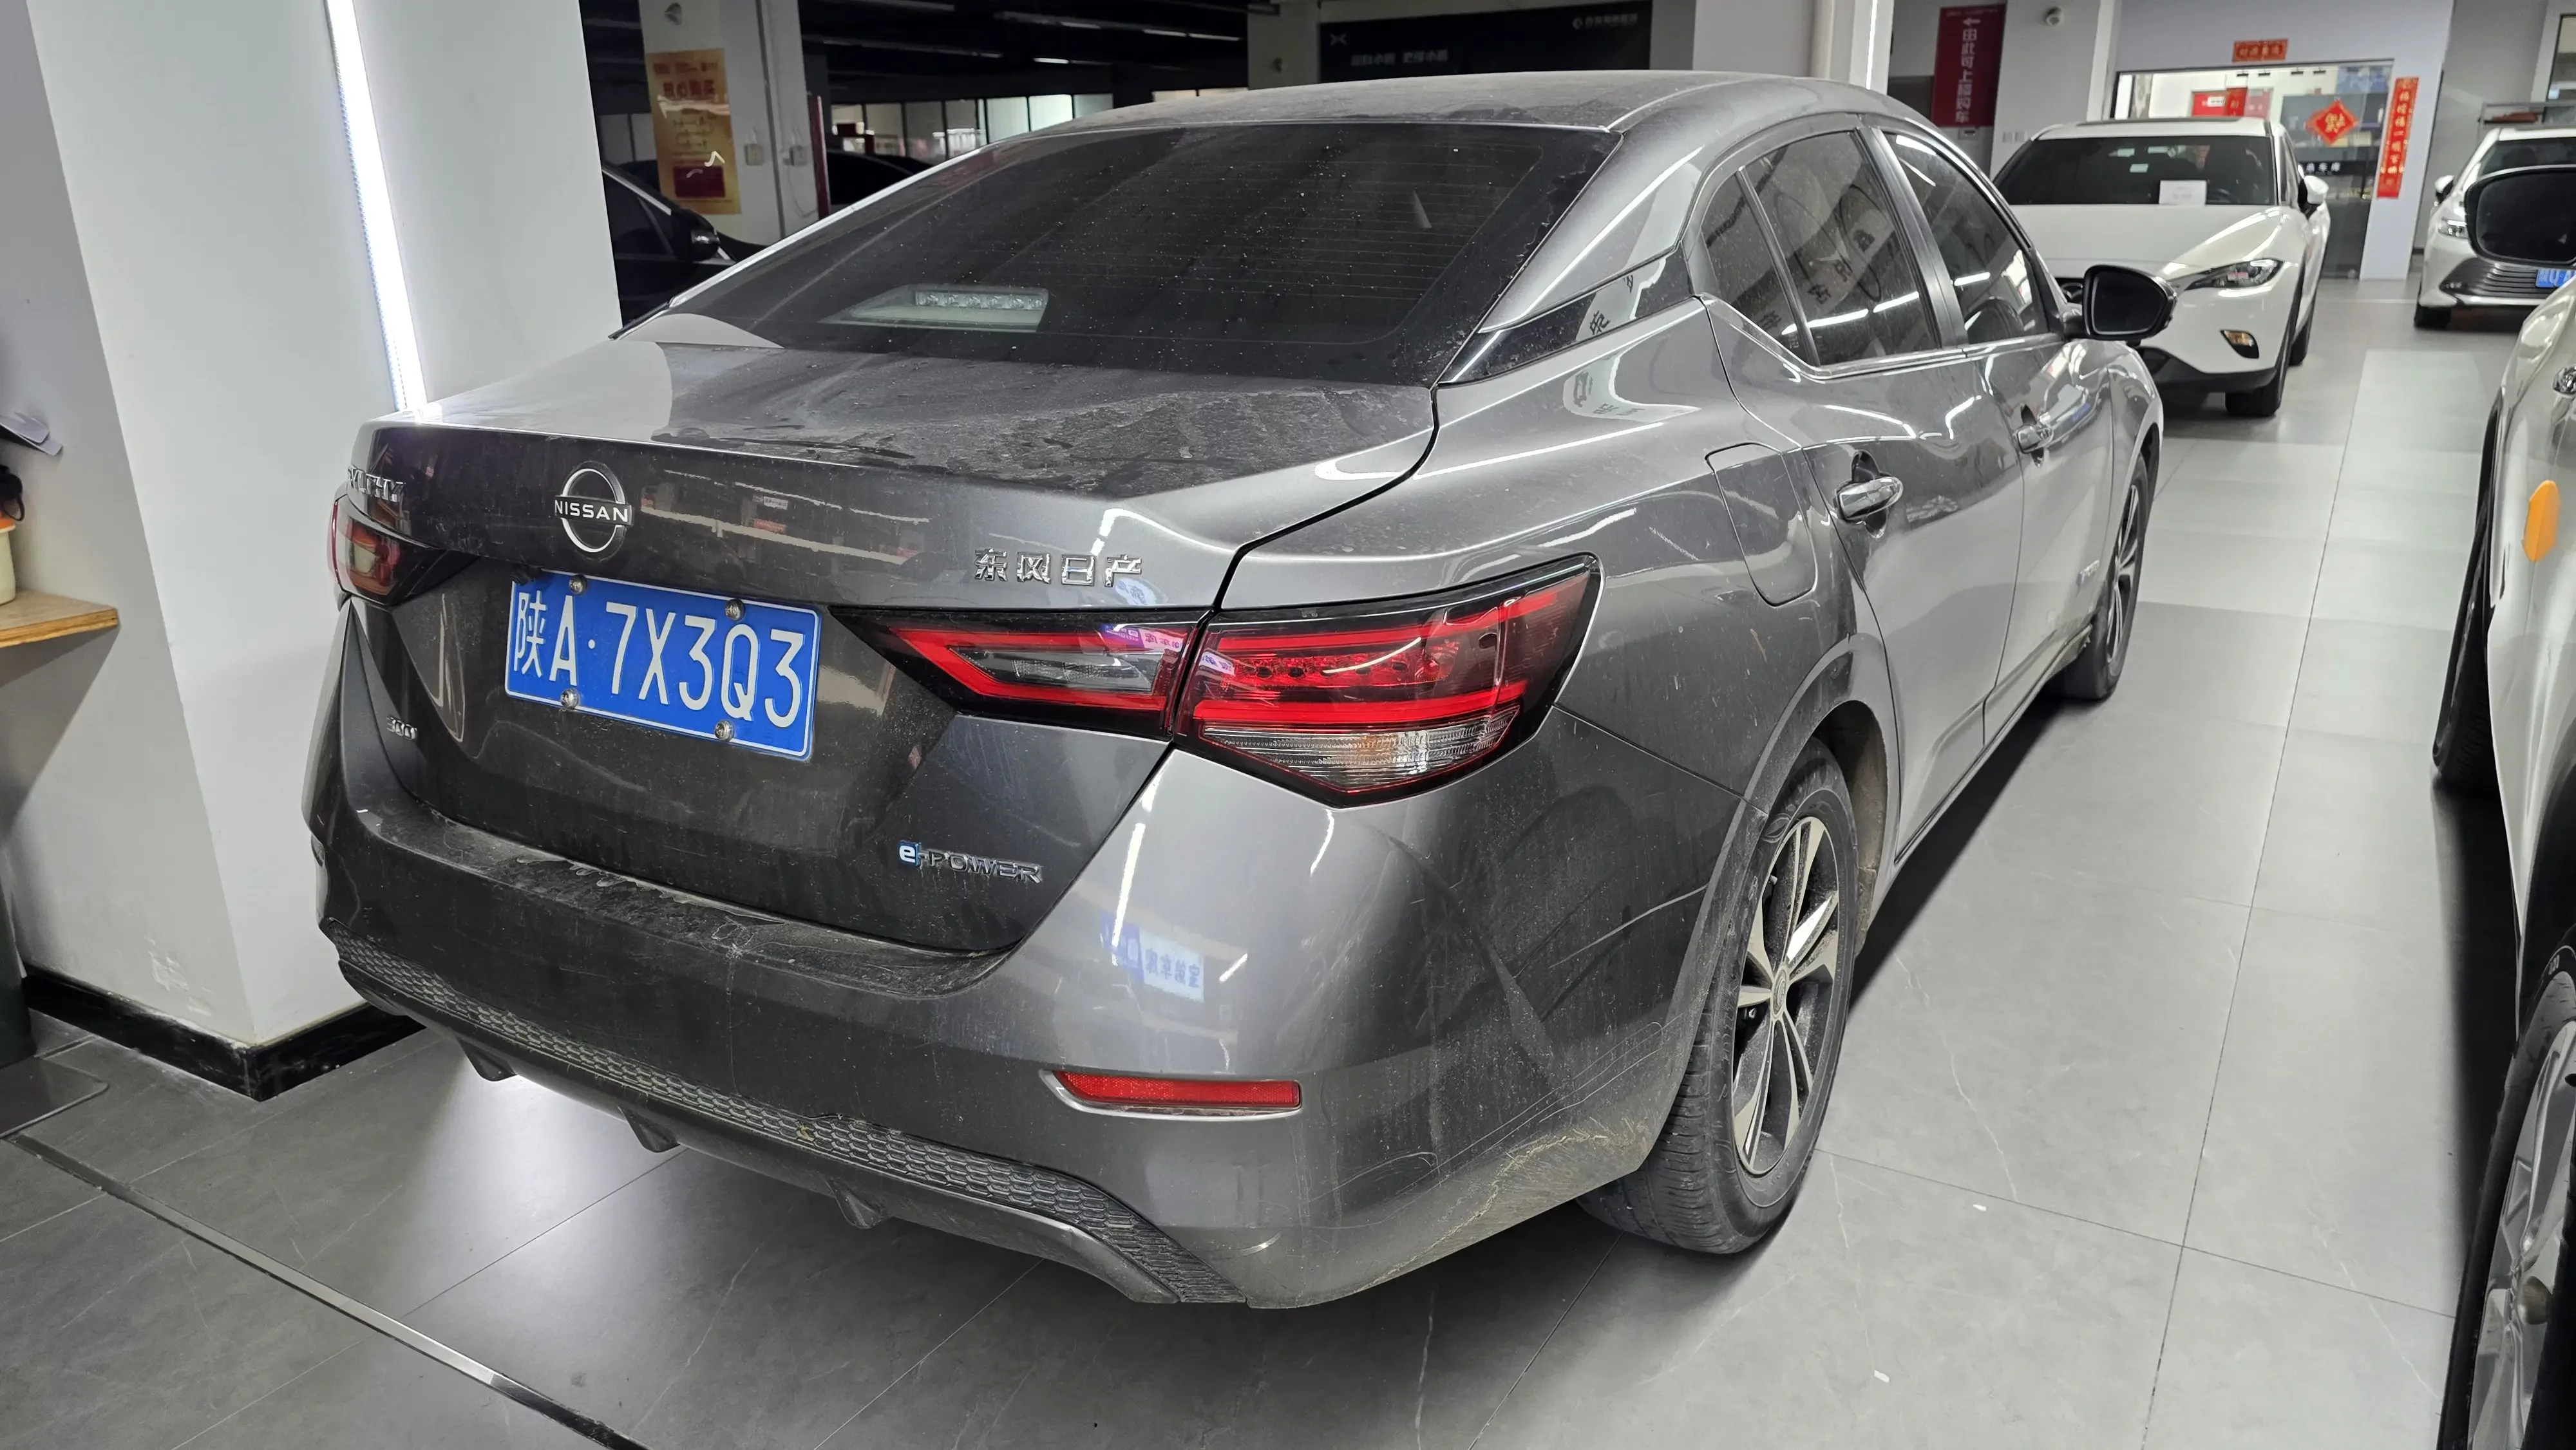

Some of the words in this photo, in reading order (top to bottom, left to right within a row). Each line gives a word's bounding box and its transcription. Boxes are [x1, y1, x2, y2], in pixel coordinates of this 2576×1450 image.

[554, 500, 628, 522] NISSAN
[974, 548, 1142, 587] 东风日产
[513, 590, 804, 728] 陕A·7X3Q3
